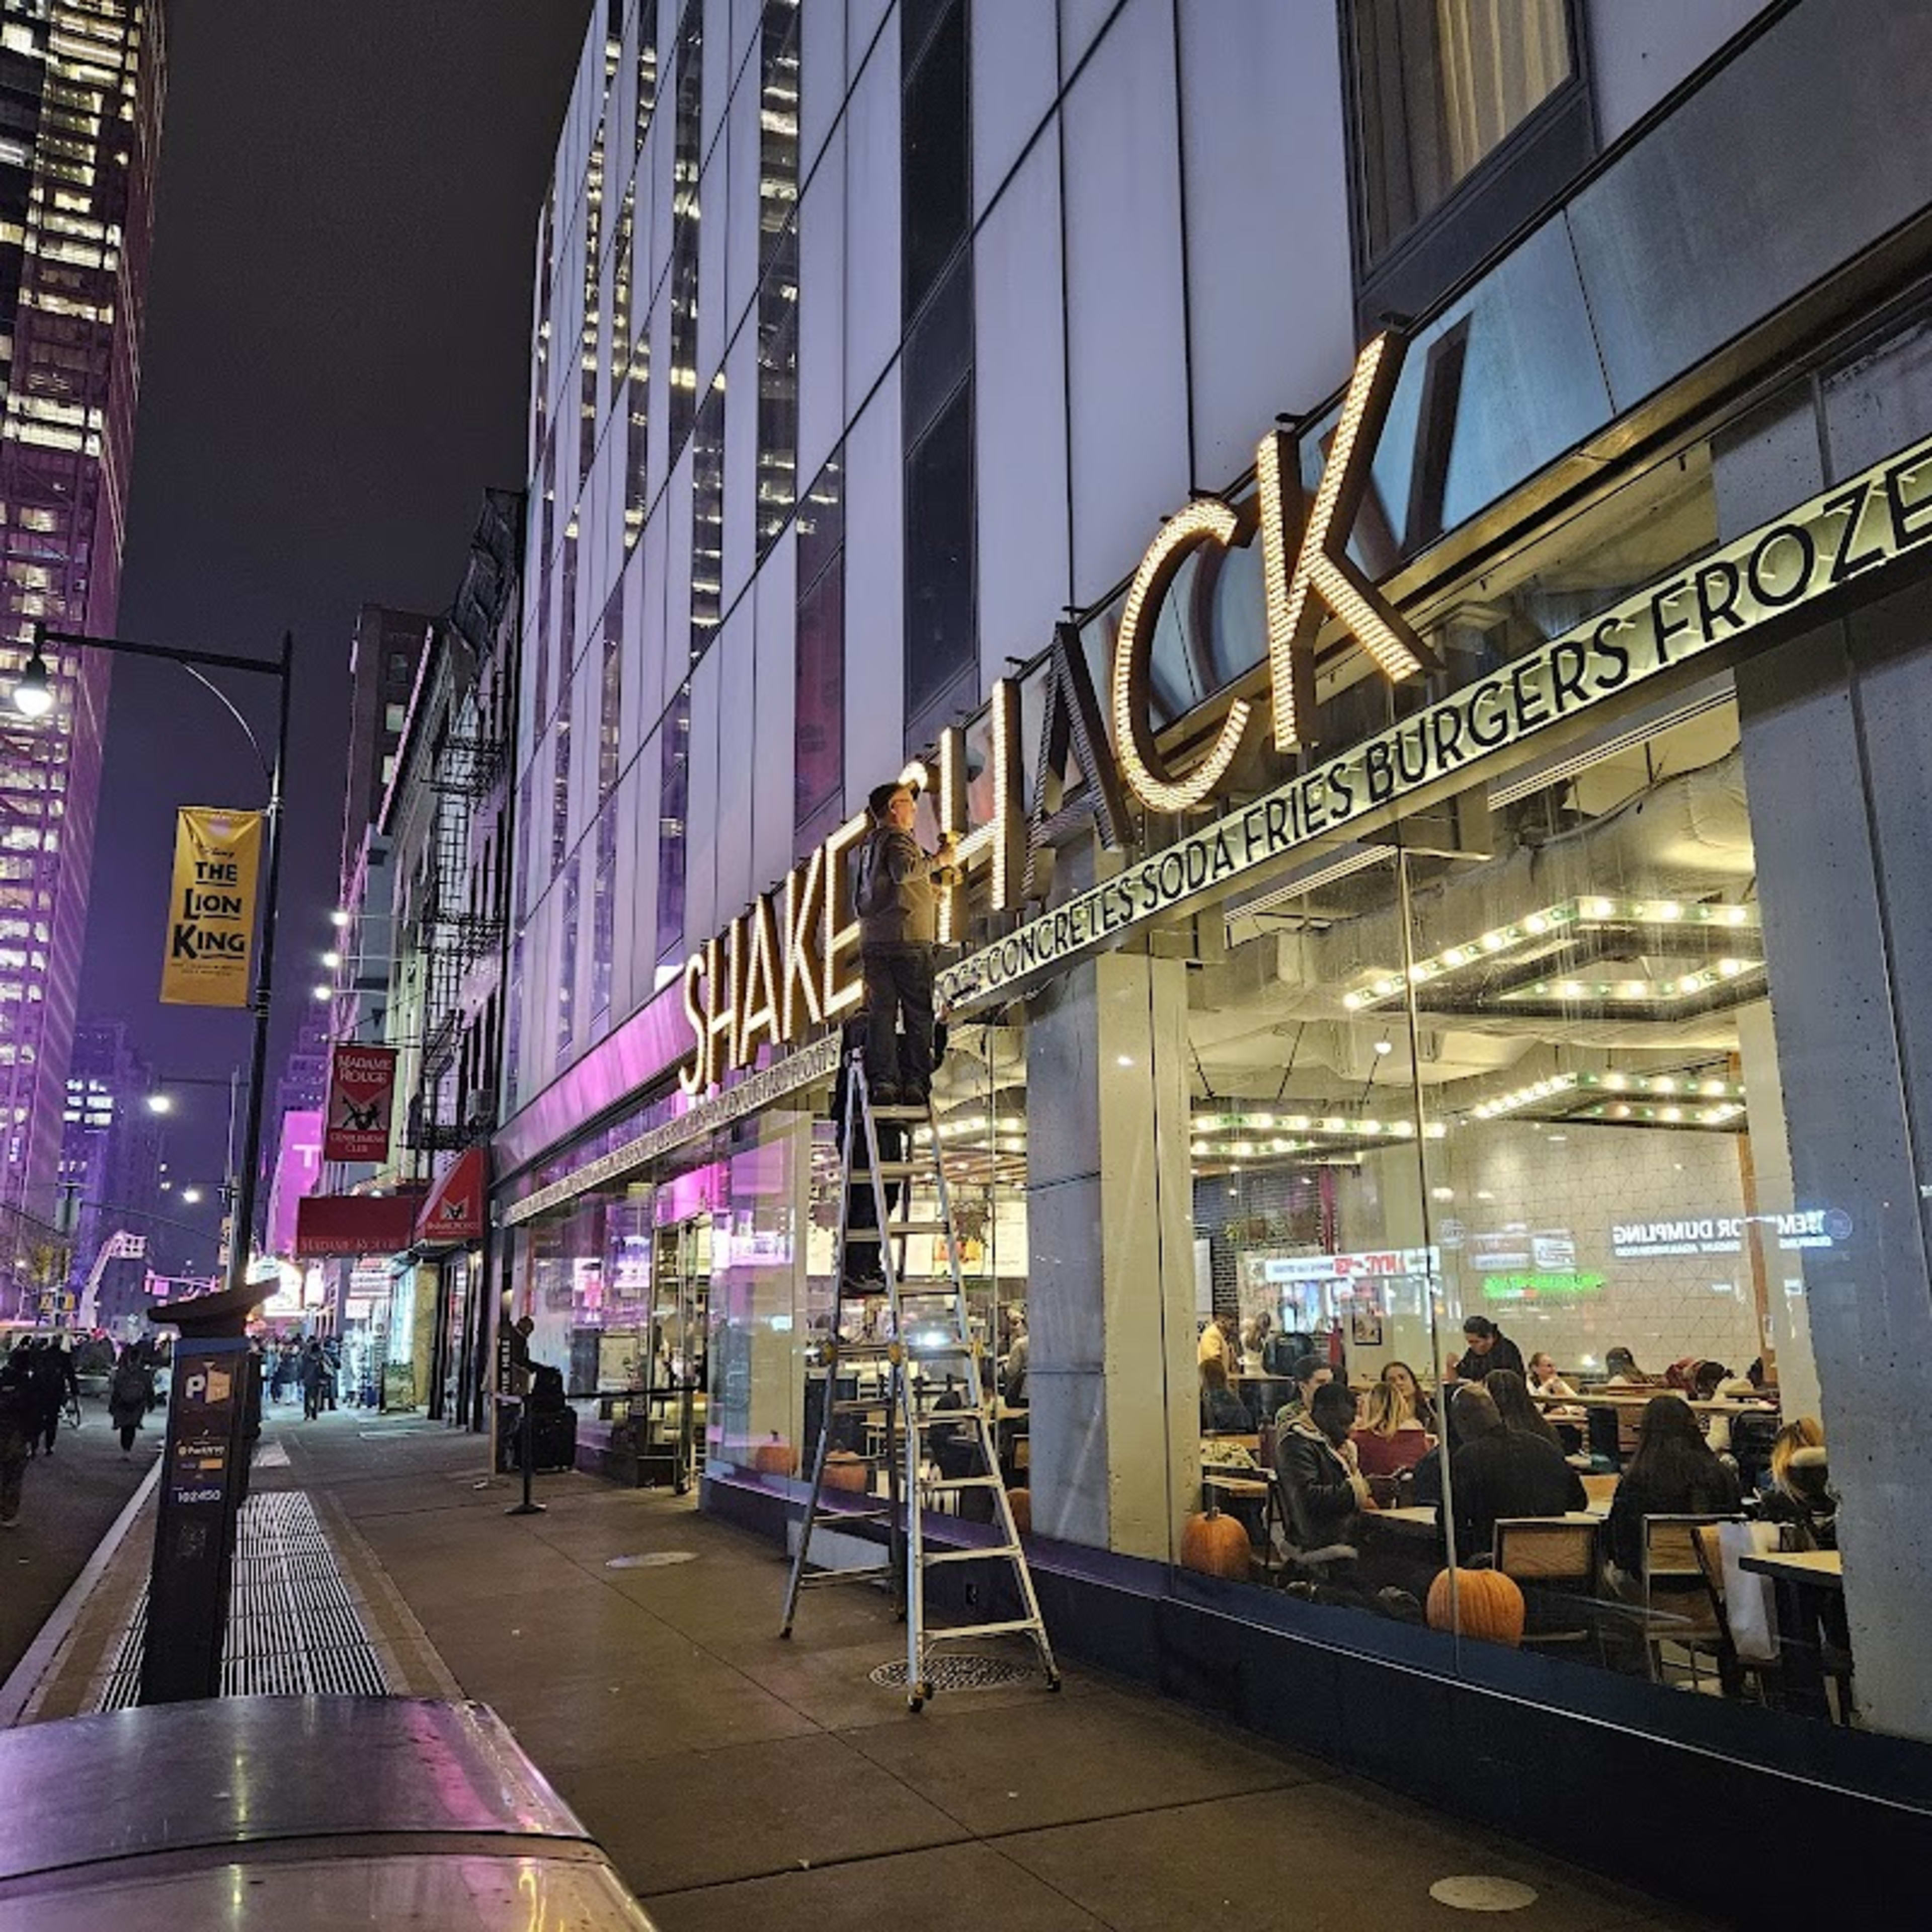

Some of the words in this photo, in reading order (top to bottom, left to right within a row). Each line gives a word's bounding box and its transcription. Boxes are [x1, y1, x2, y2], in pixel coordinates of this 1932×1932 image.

[679, 811, 868, 1095] SHAKE
[900, 331, 1434, 944] HACK
[987, 876, 1134, 986] CONCRETES
[1142, 828, 1235, 909] SODA
[1243, 762, 1352, 863] FRIES
[1365, 618, 1629, 804] BURGERS
[1651, 445, 1932, 665] FROZE
[195, 862, 237, 881] THE
[184, 888, 242, 920] LION
[172, 924, 245, 959] KING
[185, 1374, 206, 1399] P
